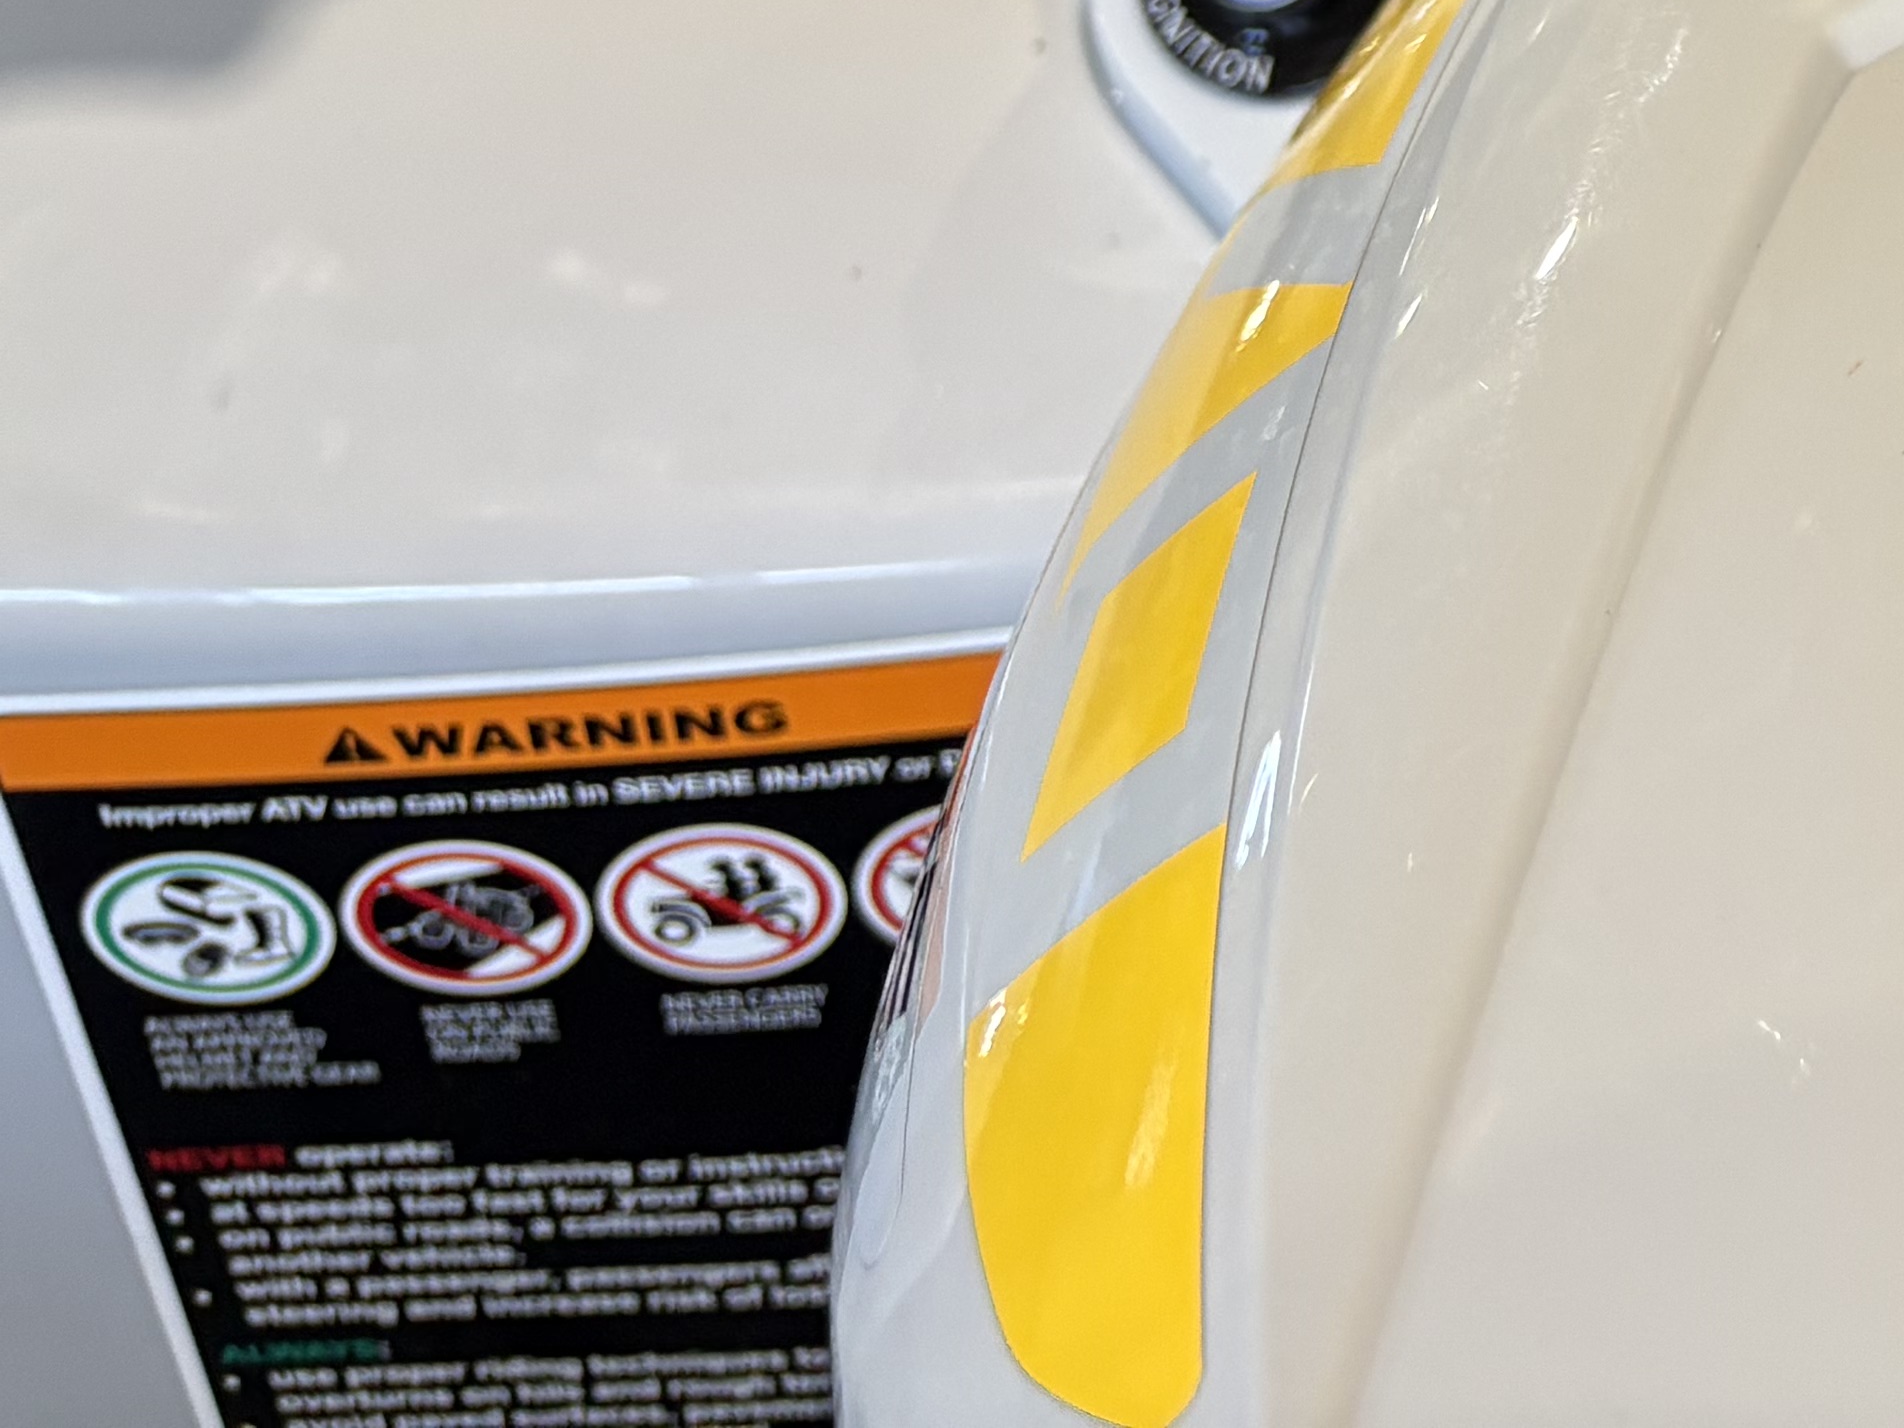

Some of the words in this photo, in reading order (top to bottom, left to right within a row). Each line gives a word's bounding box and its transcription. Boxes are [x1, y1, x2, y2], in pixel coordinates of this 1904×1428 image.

[392, 699, 789, 760] WARNING
[98, 802, 256, 829] Improper
[260, 795, 328, 822] ATV
[331, 795, 399, 820] use
[401, 791, 468, 817] can
[470, 782, 572, 813] result
[572, 780, 610, 807] in
[612, 768, 756, 805] SEVERE
[758, 755, 892, 794] INJURY
